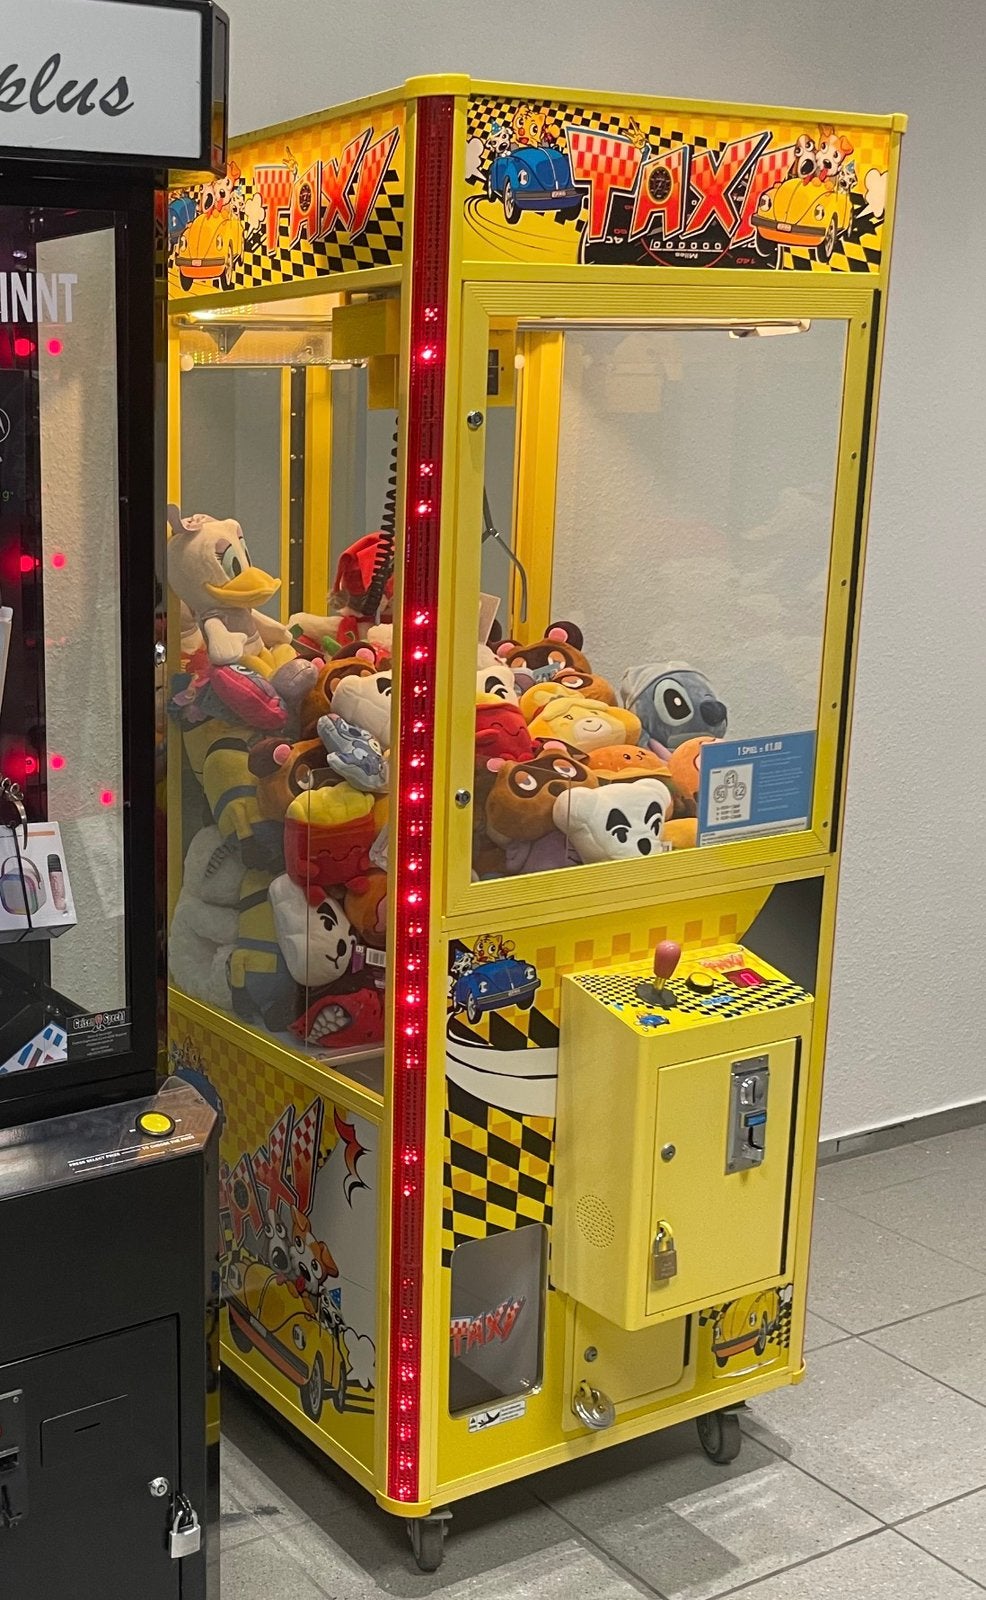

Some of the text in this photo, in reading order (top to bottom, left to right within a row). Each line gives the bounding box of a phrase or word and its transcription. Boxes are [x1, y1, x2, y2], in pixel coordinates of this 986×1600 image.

[0, 52, 134, 117] plus
[254, 126, 400, 256] TAXI
[0, 272, 78, 323] INNT
[450, 1296, 527, 1358] TAXI
